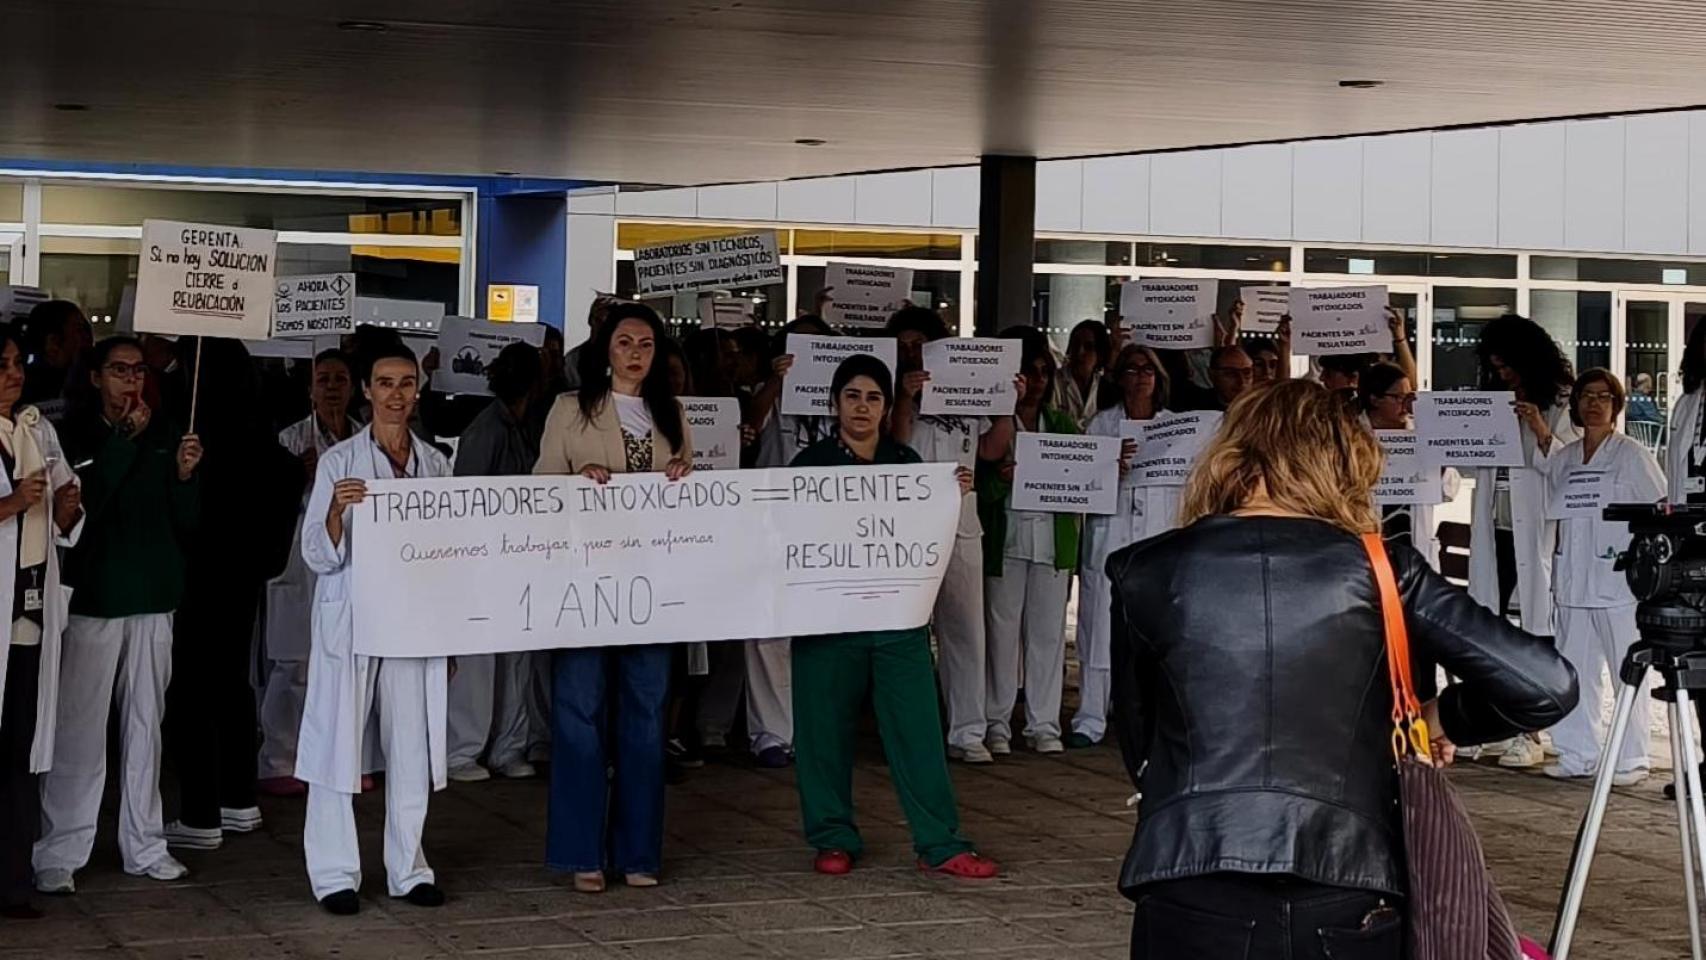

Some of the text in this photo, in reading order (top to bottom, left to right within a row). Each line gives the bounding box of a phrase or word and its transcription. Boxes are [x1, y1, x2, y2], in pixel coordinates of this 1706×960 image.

[695, 241, 710, 255] SIN
[166, 253, 180, 264] no
[183, 247, 201, 270] hoy
[638, 262, 687, 279] PACIENTES
[689, 260, 705, 273] SIN
[185, 271, 225, 289] CIERRE
[297, 280, 329, 292] AHORA
[1141, 284, 1199, 292] TRABAJADORES
[1144, 295, 1196, 303] INTOXICADOS
[1308, 291, 1366, 301] TRABAJADORES
[277, 298, 346, 313] LOS PACIENTES
[1311, 303, 1364, 312] INTOXICADOS
[276, 315, 352, 332] SOMOS NOSOTROS
[1146, 333, 1193, 342] RESULTADOS
[1301, 328, 1355, 338] PACIENTES SIN
[811, 341, 874, 352] TRABAJADORES
[944, 344, 1003, 353] TRABAJADORES
[1317, 340, 1367, 349] RESULTADOS
[949, 356, 999, 365] INTOXICADOS
[795, 385, 830, 393] PACIENT
[932, 386, 985, 395] PACIENTES SIN
[944, 399, 992, 407] RESULTADOS
[1433, 397, 1493, 405] TRABAJADORES
[1438, 409, 1491, 417] INTOXICADOS
[1143, 416, 1200, 432] TRABAJADORES
[1039, 439, 1098, 450] TRABAJADORES
[1428, 438, 1470, 447] PACIENTES
[1041, 452, 1094, 462] INTOXICADOS
[1445, 450, 1496, 458] RESULTADOS
[1172, 457, 1186, 465] SIN
[1024, 482, 1080, 491] PACIENTES SIN
[369, 486, 564, 523] TRABAJADORES
[577, 481, 742, 513] INTOXICADOS
[792, 473, 933, 503] PACIENTES
[1040, 495, 1089, 504] RESULTADOS
[400, 543, 489, 563] Queremos
[620, 536, 642, 548] sin
[651, 530, 714, 554] enfermar
[786, 542, 940, 569] RESULTADOS
[518, 582, 533, 632] 1
[555, 575, 653, 628] AÑO
